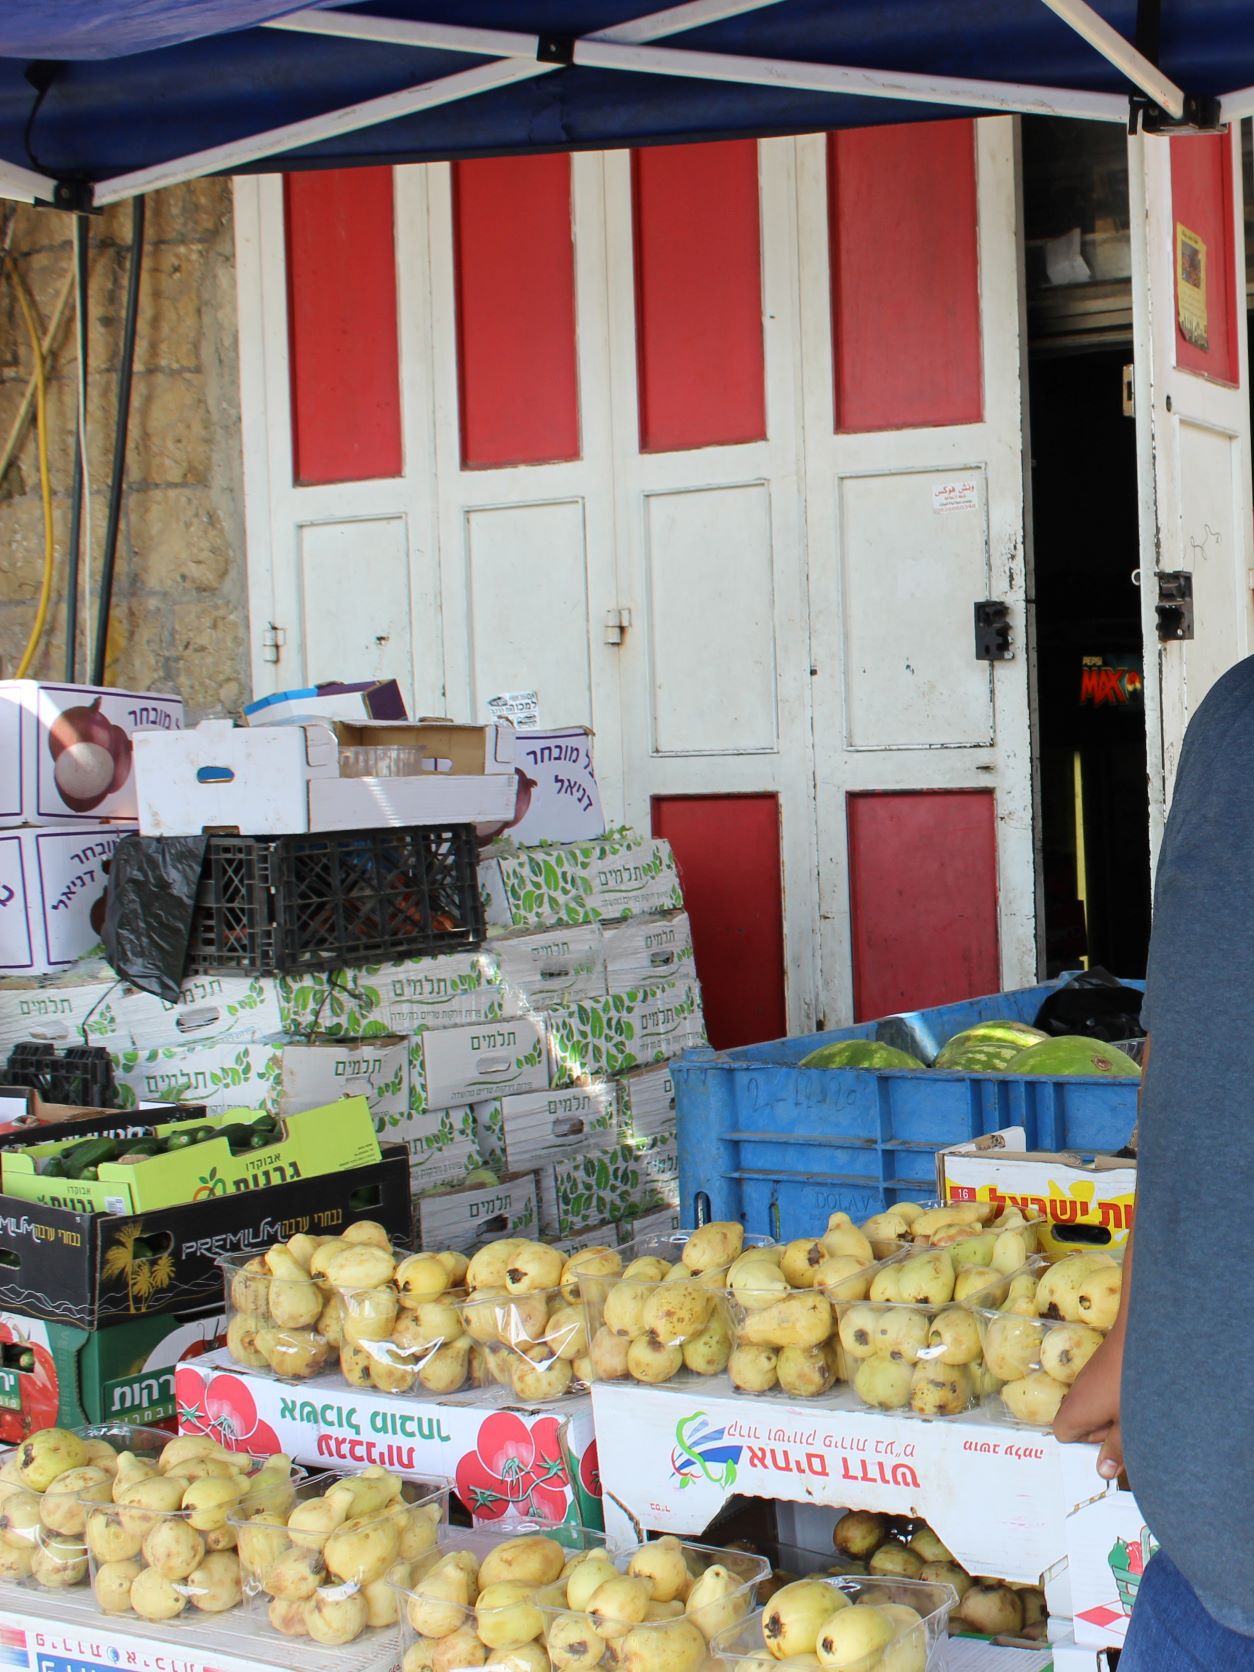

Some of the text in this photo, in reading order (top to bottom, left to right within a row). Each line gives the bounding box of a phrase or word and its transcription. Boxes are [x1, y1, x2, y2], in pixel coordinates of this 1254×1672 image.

[1080, 667, 1128, 704] MAX
[128, 707, 171, 730] מובחר
[526, 744, 579, 765] מובחר
[554, 774, 593, 812] דניאל
[598, 864, 642, 886] תלמים
[51, 869, 96, 910] דניאל
[645, 929, 676, 949] תלמים
[161, 978, 222, 1011] תלמ
[392, 975, 447, 996] תלמים
[20, 997, 72, 1015] תלמים
[641, 1007, 674, 1029] תלמים
[470, 1031, 516, 1050] תלמים
[335, 1057, 382, 1076] תלמים
[145, 1069, 207, 1093] תלמים
[548, 1095, 591, 1114] תלמים
[245, 1153, 281, 1171] אבוקדו
[232, 1160, 302, 1192] גרנות
[469, 1193, 512, 1218] תלמים
[816, 1192, 871, 1212] DOLAV
[958, 1188, 969, 1200] 16
[988, 1188, 1089, 1223] ישראל
[0, 1216, 41, 1243] MIUM
[281, 1208, 342, 1236] נבחרי ערבה
[181, 1217, 289, 1260] PREMIUM
[111, 1374, 175, 1411] רקות
[280, 1397, 451, 1442] אשכול מובחר
[727, 1420, 761, 1440] קרור
[767, 1428, 816, 1446] ושיווק
[823, 1435, 868, 1452] פירות
[317, 1434, 416, 1469] עגבניות
[963, 1441, 1044, 1460] מושב עלמה
[745, 1445, 920, 1488] אחים דדוש
[36, 1633, 102, 1657] פירות
